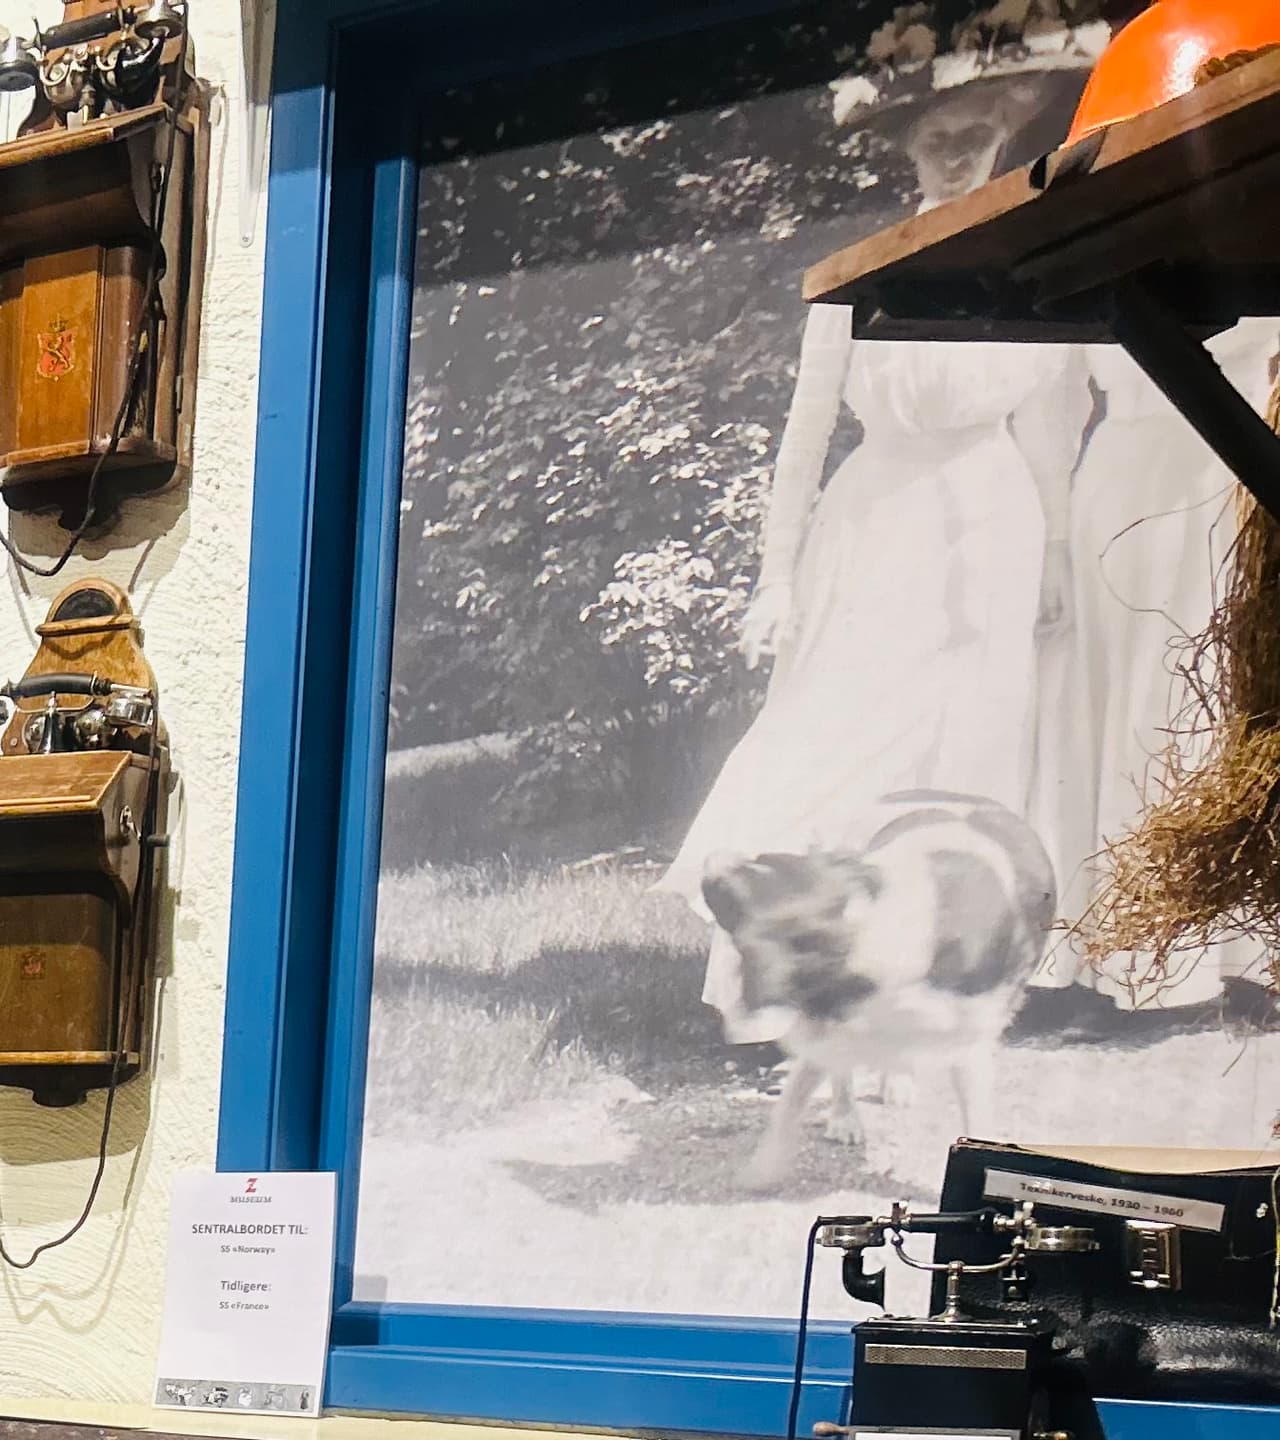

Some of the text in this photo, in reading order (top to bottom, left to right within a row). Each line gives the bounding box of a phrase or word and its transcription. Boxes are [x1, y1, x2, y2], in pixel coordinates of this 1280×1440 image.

[192, 1223, 308, 1235] SENTRALBORDET TIL:
[220, 1245, 231, 1253] SS
[220, 1280, 272, 1293] Tidligere:
